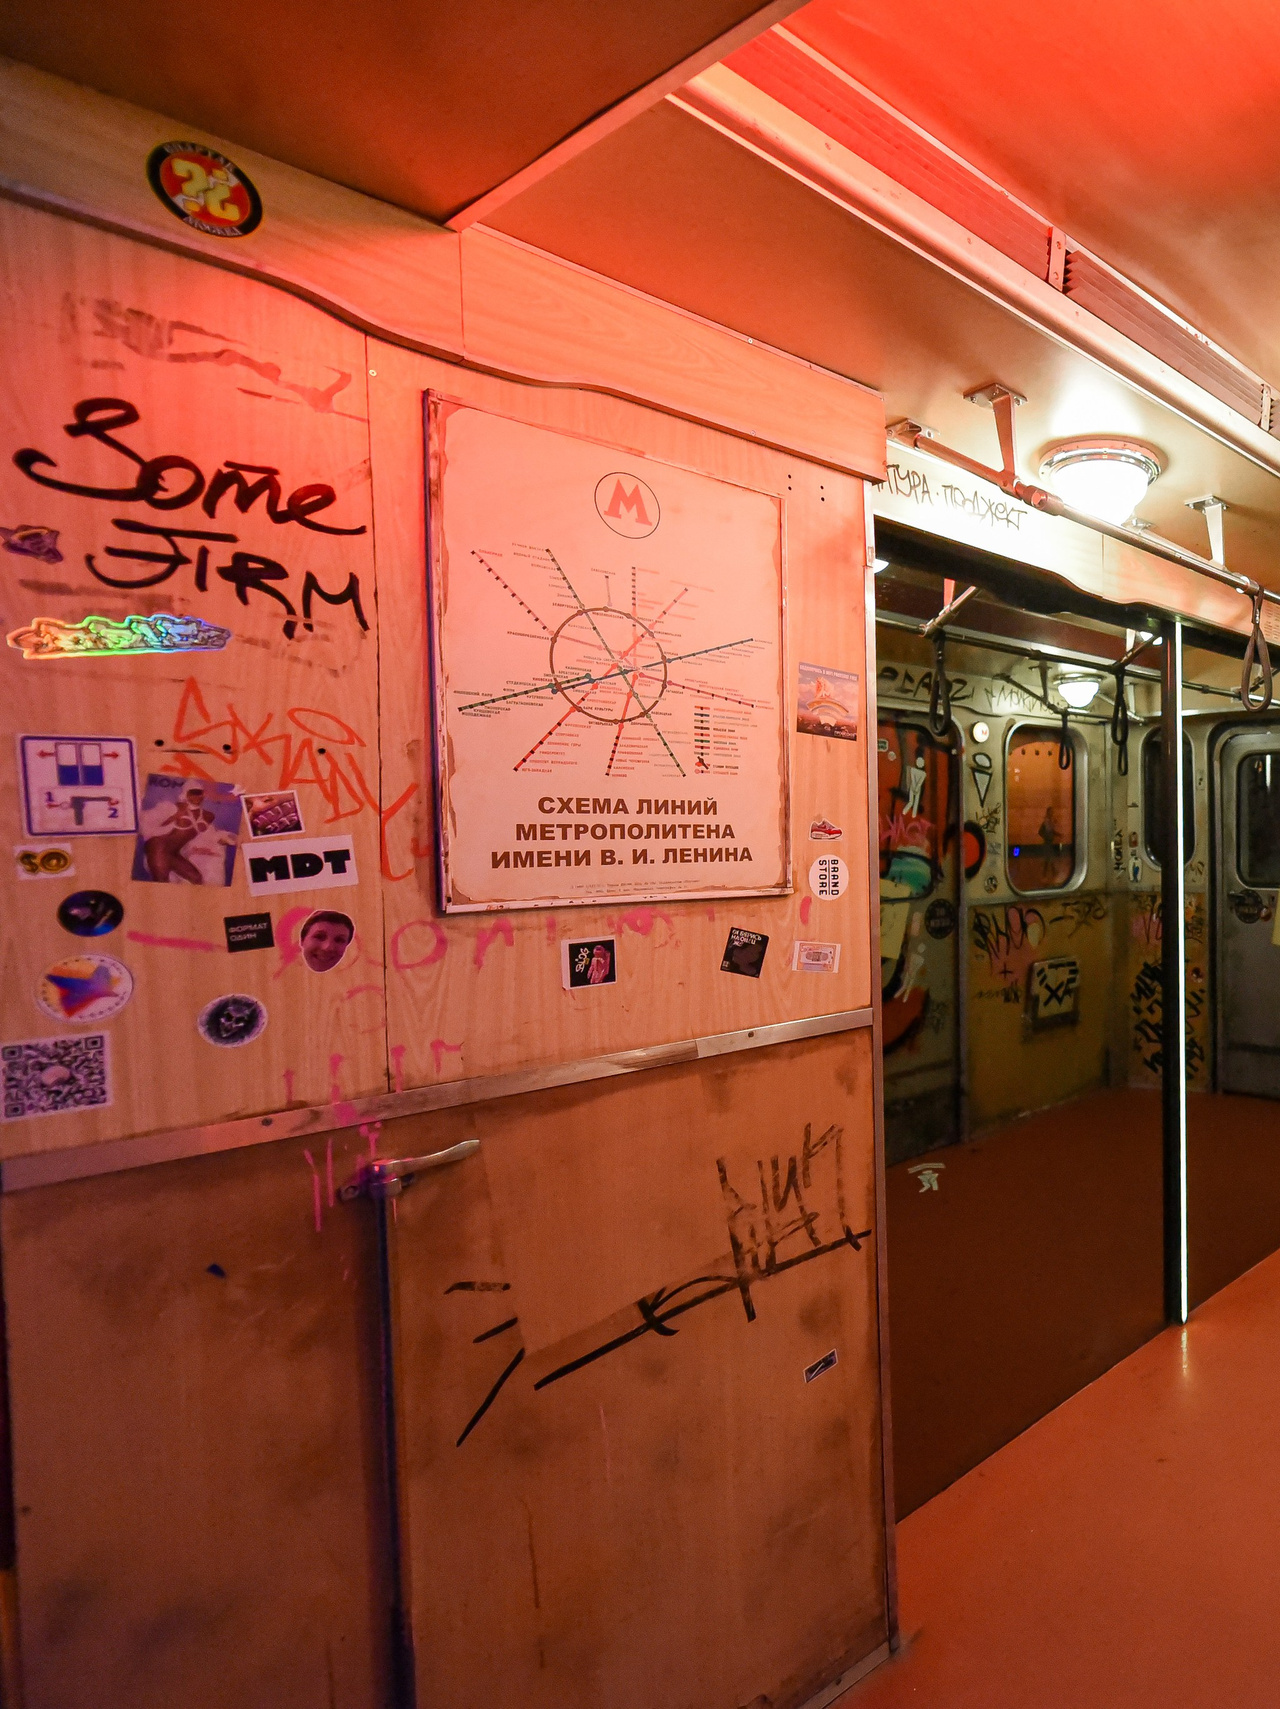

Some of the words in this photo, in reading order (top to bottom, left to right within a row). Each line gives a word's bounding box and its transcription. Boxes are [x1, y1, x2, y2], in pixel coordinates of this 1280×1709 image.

[538, 796, 629, 815] СХЕМА
[636, 796, 718, 816] ЛИНИЙ
[515, 823, 735, 841] МЕТРОПОЛИТЕНА
[250, 848, 352, 885] MDT
[491, 849, 592, 869] ИМЕНИ
[600, 848, 623, 866] В.
[632, 848, 654, 865] И.
[662, 846, 753, 864] ЛЕНИНА
[818, 859, 827, 896] STORE
[831, 859, 839, 896] BRAND
[229, 922, 267, 933] ФОРМАТ
[230, 933, 257, 942] ОДИН
